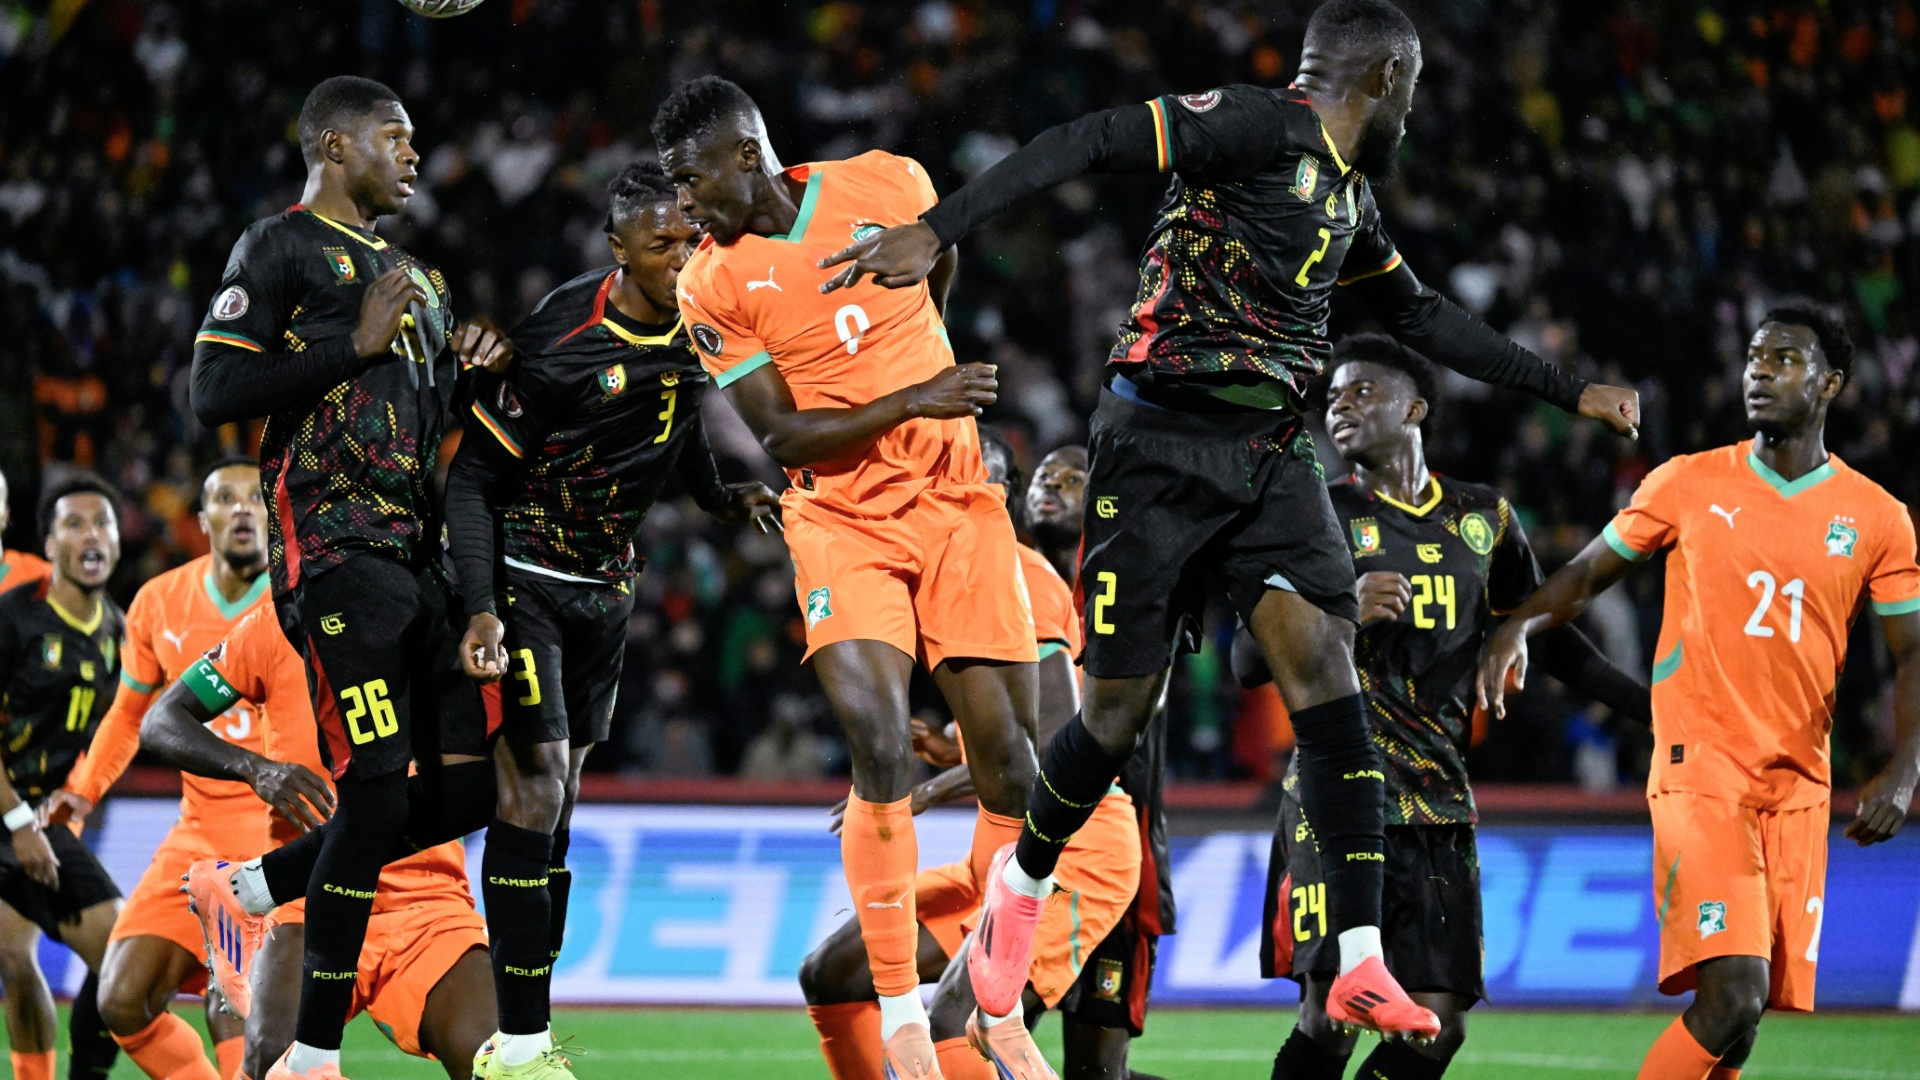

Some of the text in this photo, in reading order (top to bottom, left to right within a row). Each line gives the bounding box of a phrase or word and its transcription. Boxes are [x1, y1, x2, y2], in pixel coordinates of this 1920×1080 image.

[1295, 228, 1331, 287] 2
[834, 304, 870, 355] 9
[653, 389, 676, 444] 3
[1094, 572, 1116, 635] 2
[1410, 575, 1456, 630] 24
[1744, 570, 1804, 643] 21
[199, 663, 231, 697] CAF
[510, 648, 541, 706] 3
[340, 679, 399, 745] 26
[1292, 882, 1327, 942] 24
